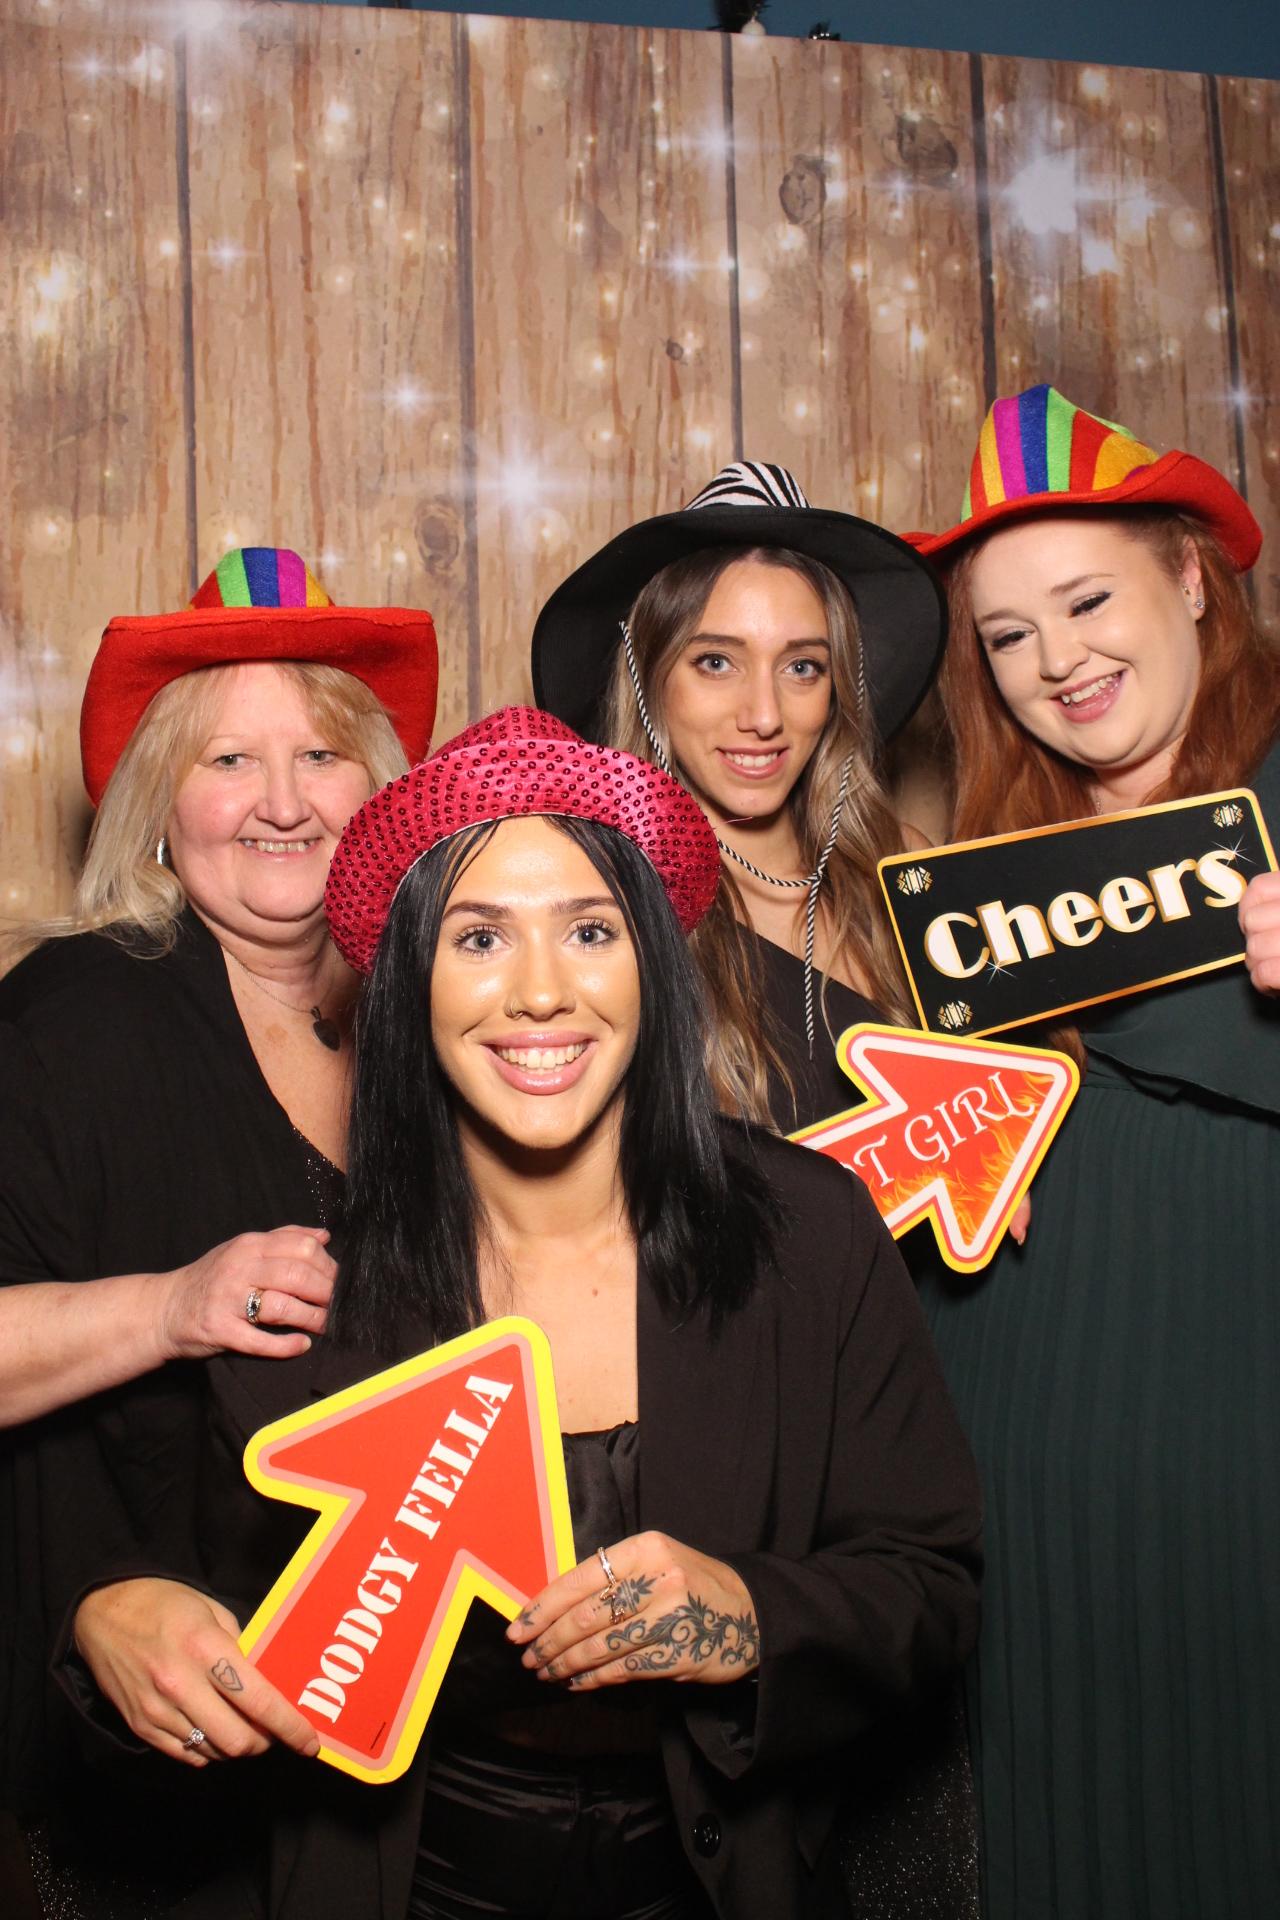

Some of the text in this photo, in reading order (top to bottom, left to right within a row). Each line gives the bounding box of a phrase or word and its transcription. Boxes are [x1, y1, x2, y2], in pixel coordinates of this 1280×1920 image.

[924, 849, 1248, 978] Cheers
[904, 1071, 1035, 1163] GIRL
[298, 1375, 514, 1723] DODGY FELLA
